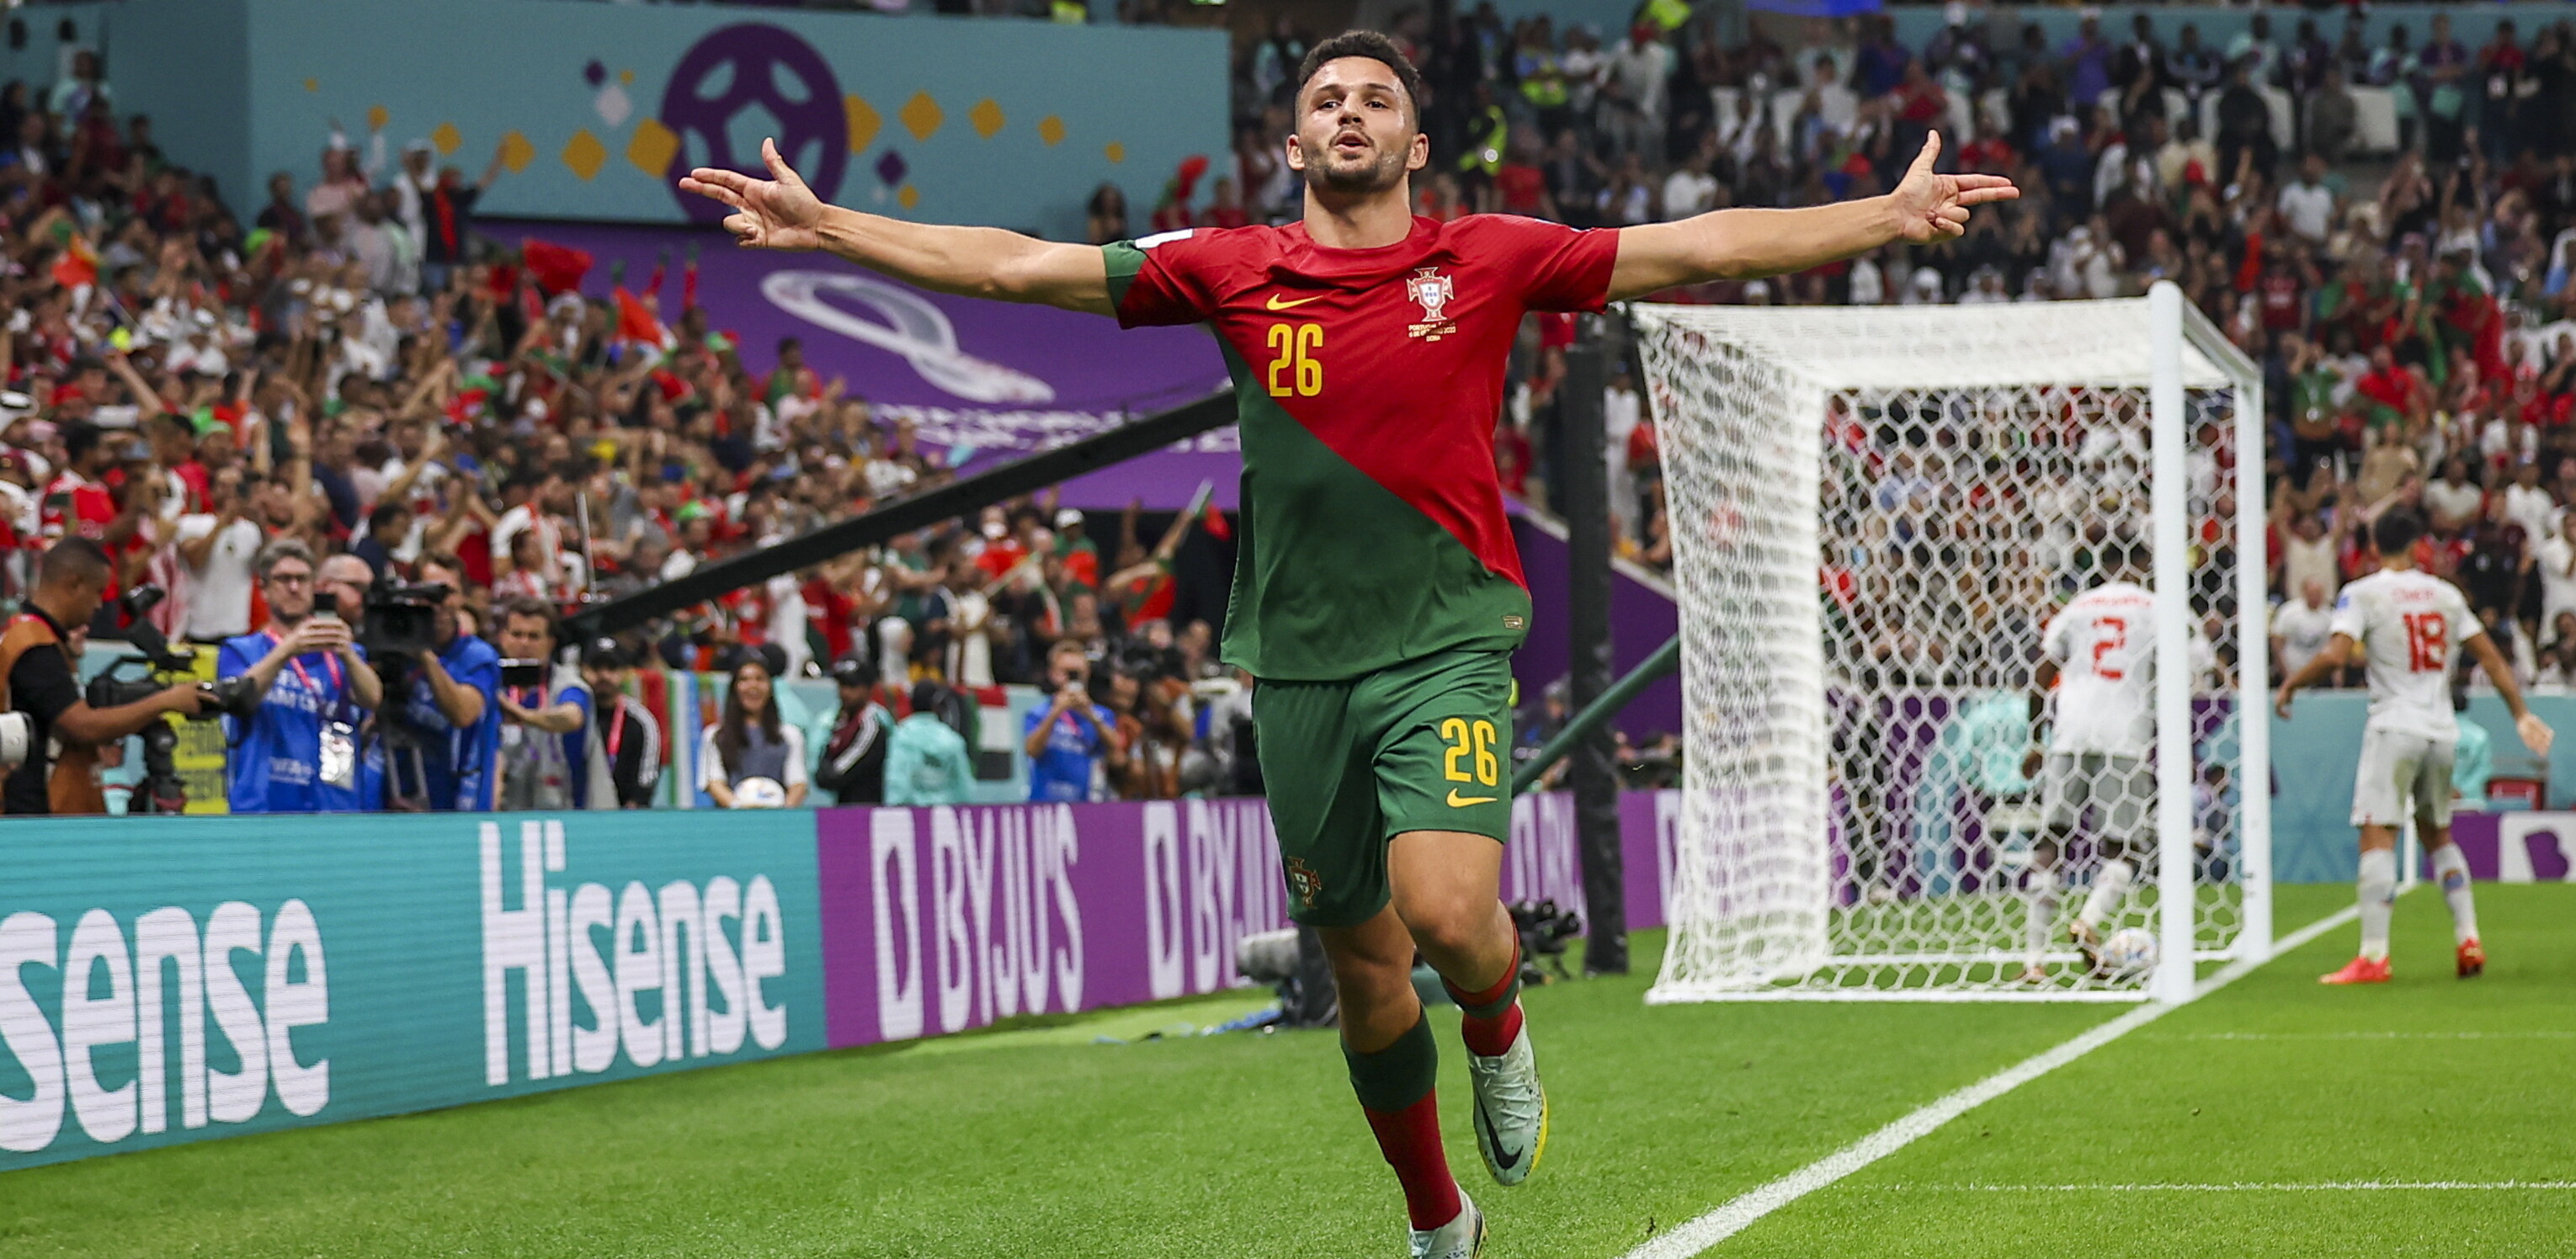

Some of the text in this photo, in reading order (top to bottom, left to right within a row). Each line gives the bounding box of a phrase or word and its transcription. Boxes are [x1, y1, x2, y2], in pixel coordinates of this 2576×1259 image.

[1267, 323, 1323, 397] 26
[2093, 616, 2126, 681] 2
[2403, 613, 2447, 674] 18
[1440, 717, 1498, 787] 26
[479, 819, 787, 1086] Hisense
[930, 802, 1084, 1033] BYJU'S
[1187, 799, 1280, 993] BYJU
[0, 898, 330, 1153] sense
